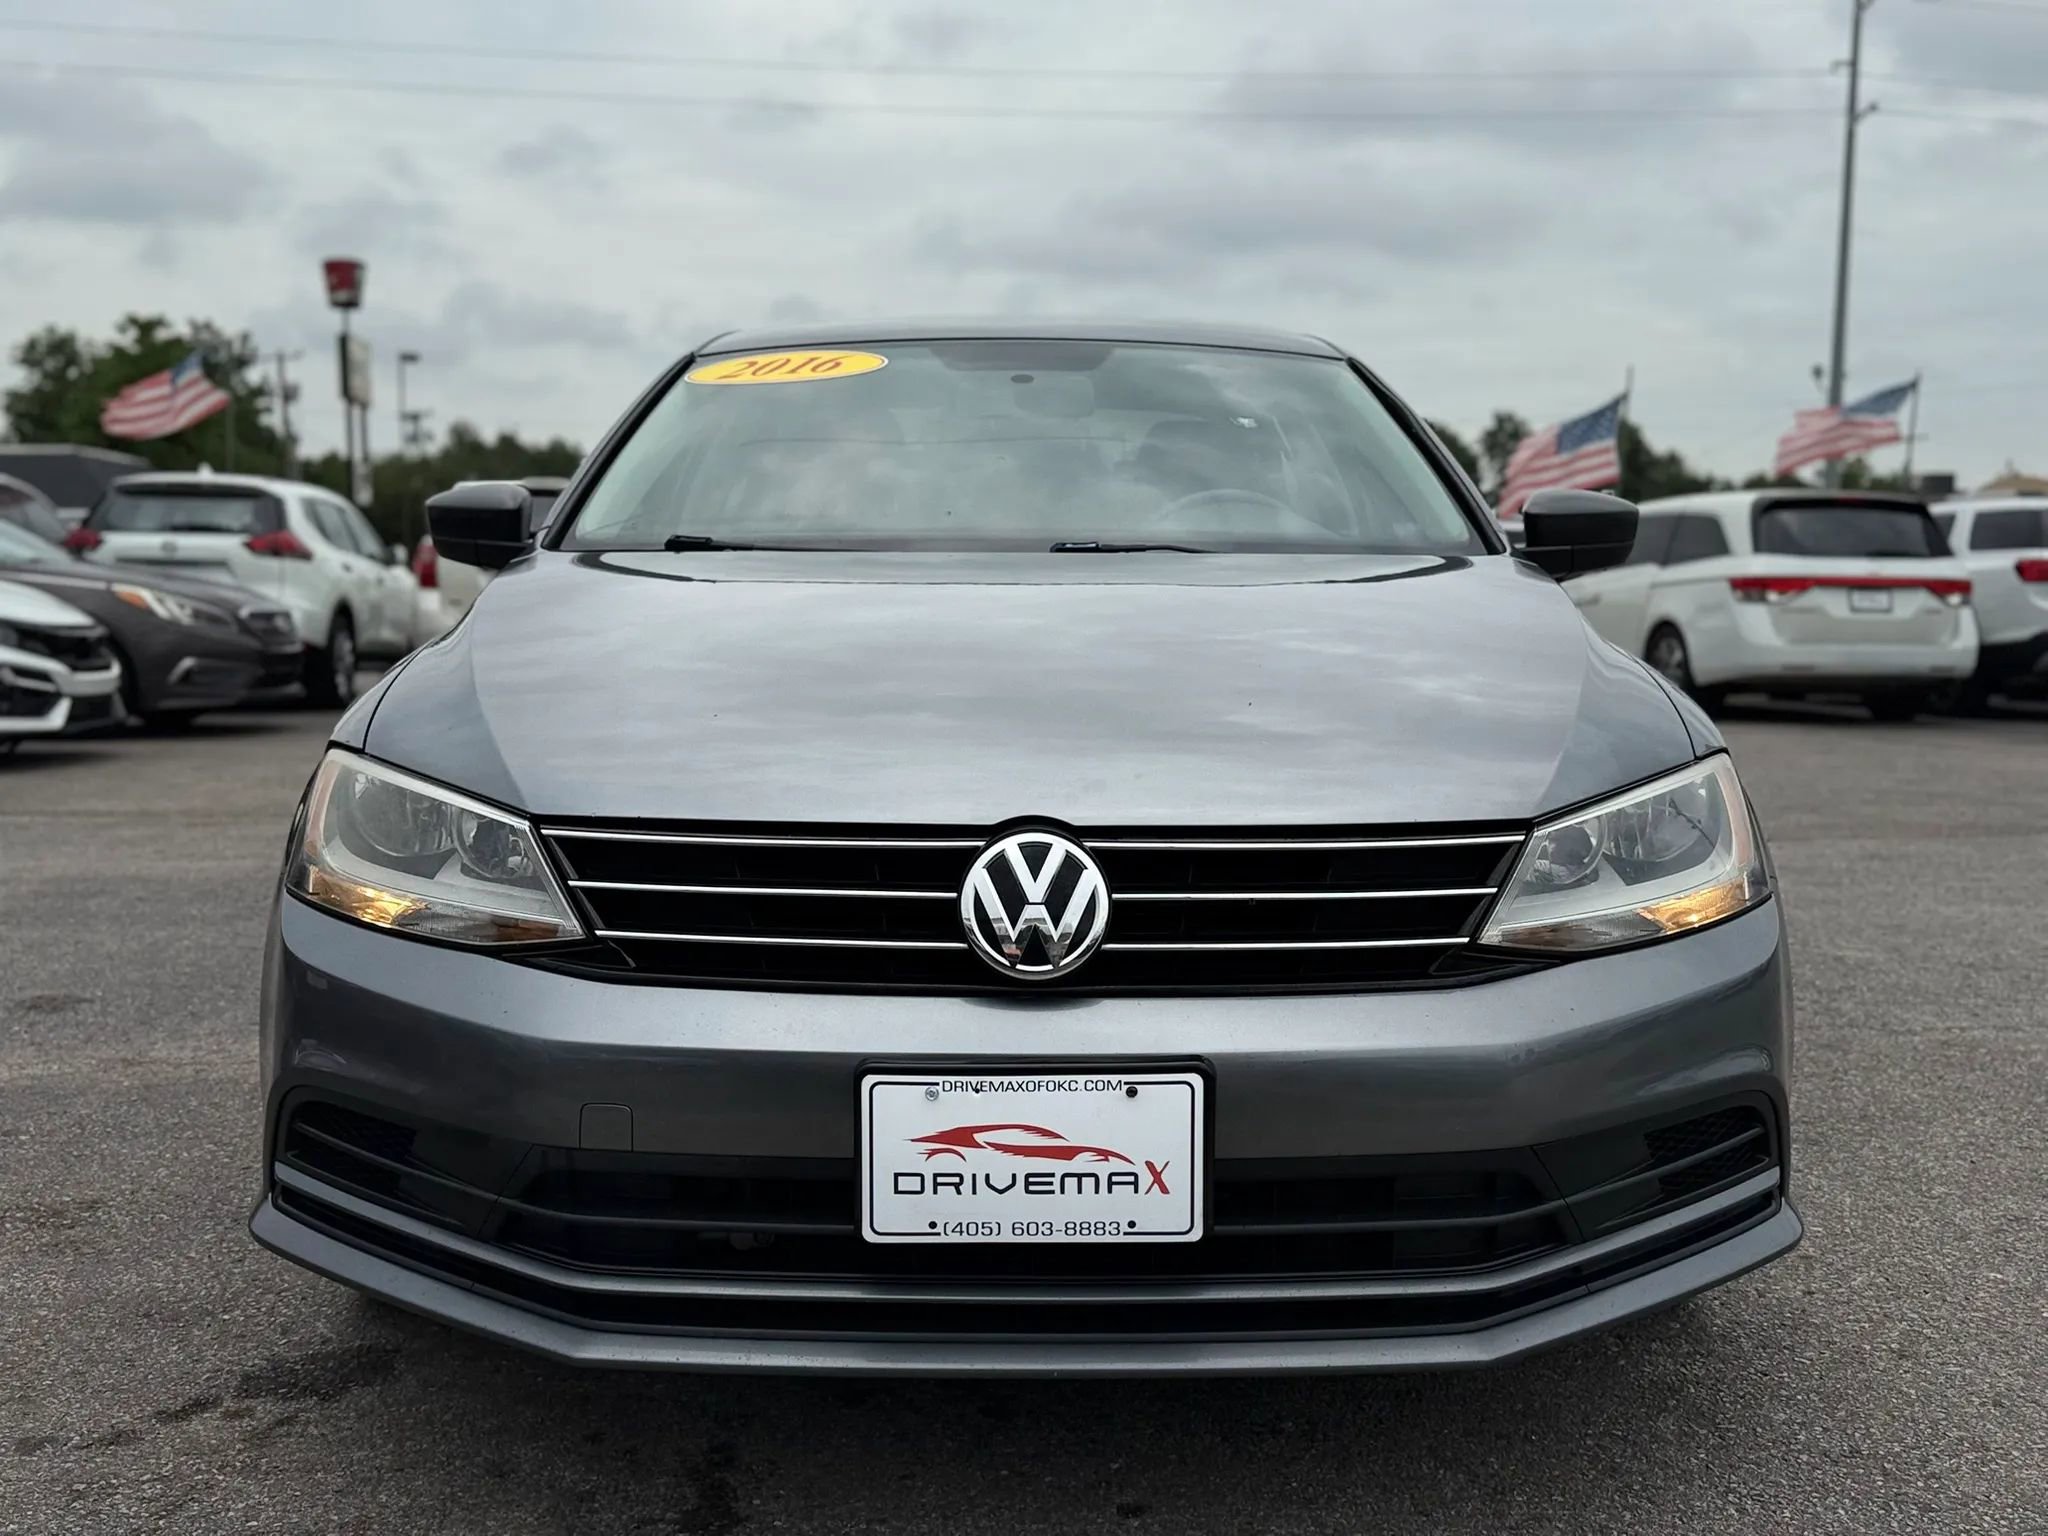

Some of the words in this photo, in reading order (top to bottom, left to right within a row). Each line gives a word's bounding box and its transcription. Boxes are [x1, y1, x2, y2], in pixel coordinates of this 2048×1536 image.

[715, 354, 850, 380] 2016
[941, 1079, 1123, 1093] DRIVEMAXOFOKC.COM
[893, 1160, 1171, 1195] DRIVEMAX
[942, 1221, 1002, 1237] (405)
[1011, 1220, 1122, 1236] 603-8883
